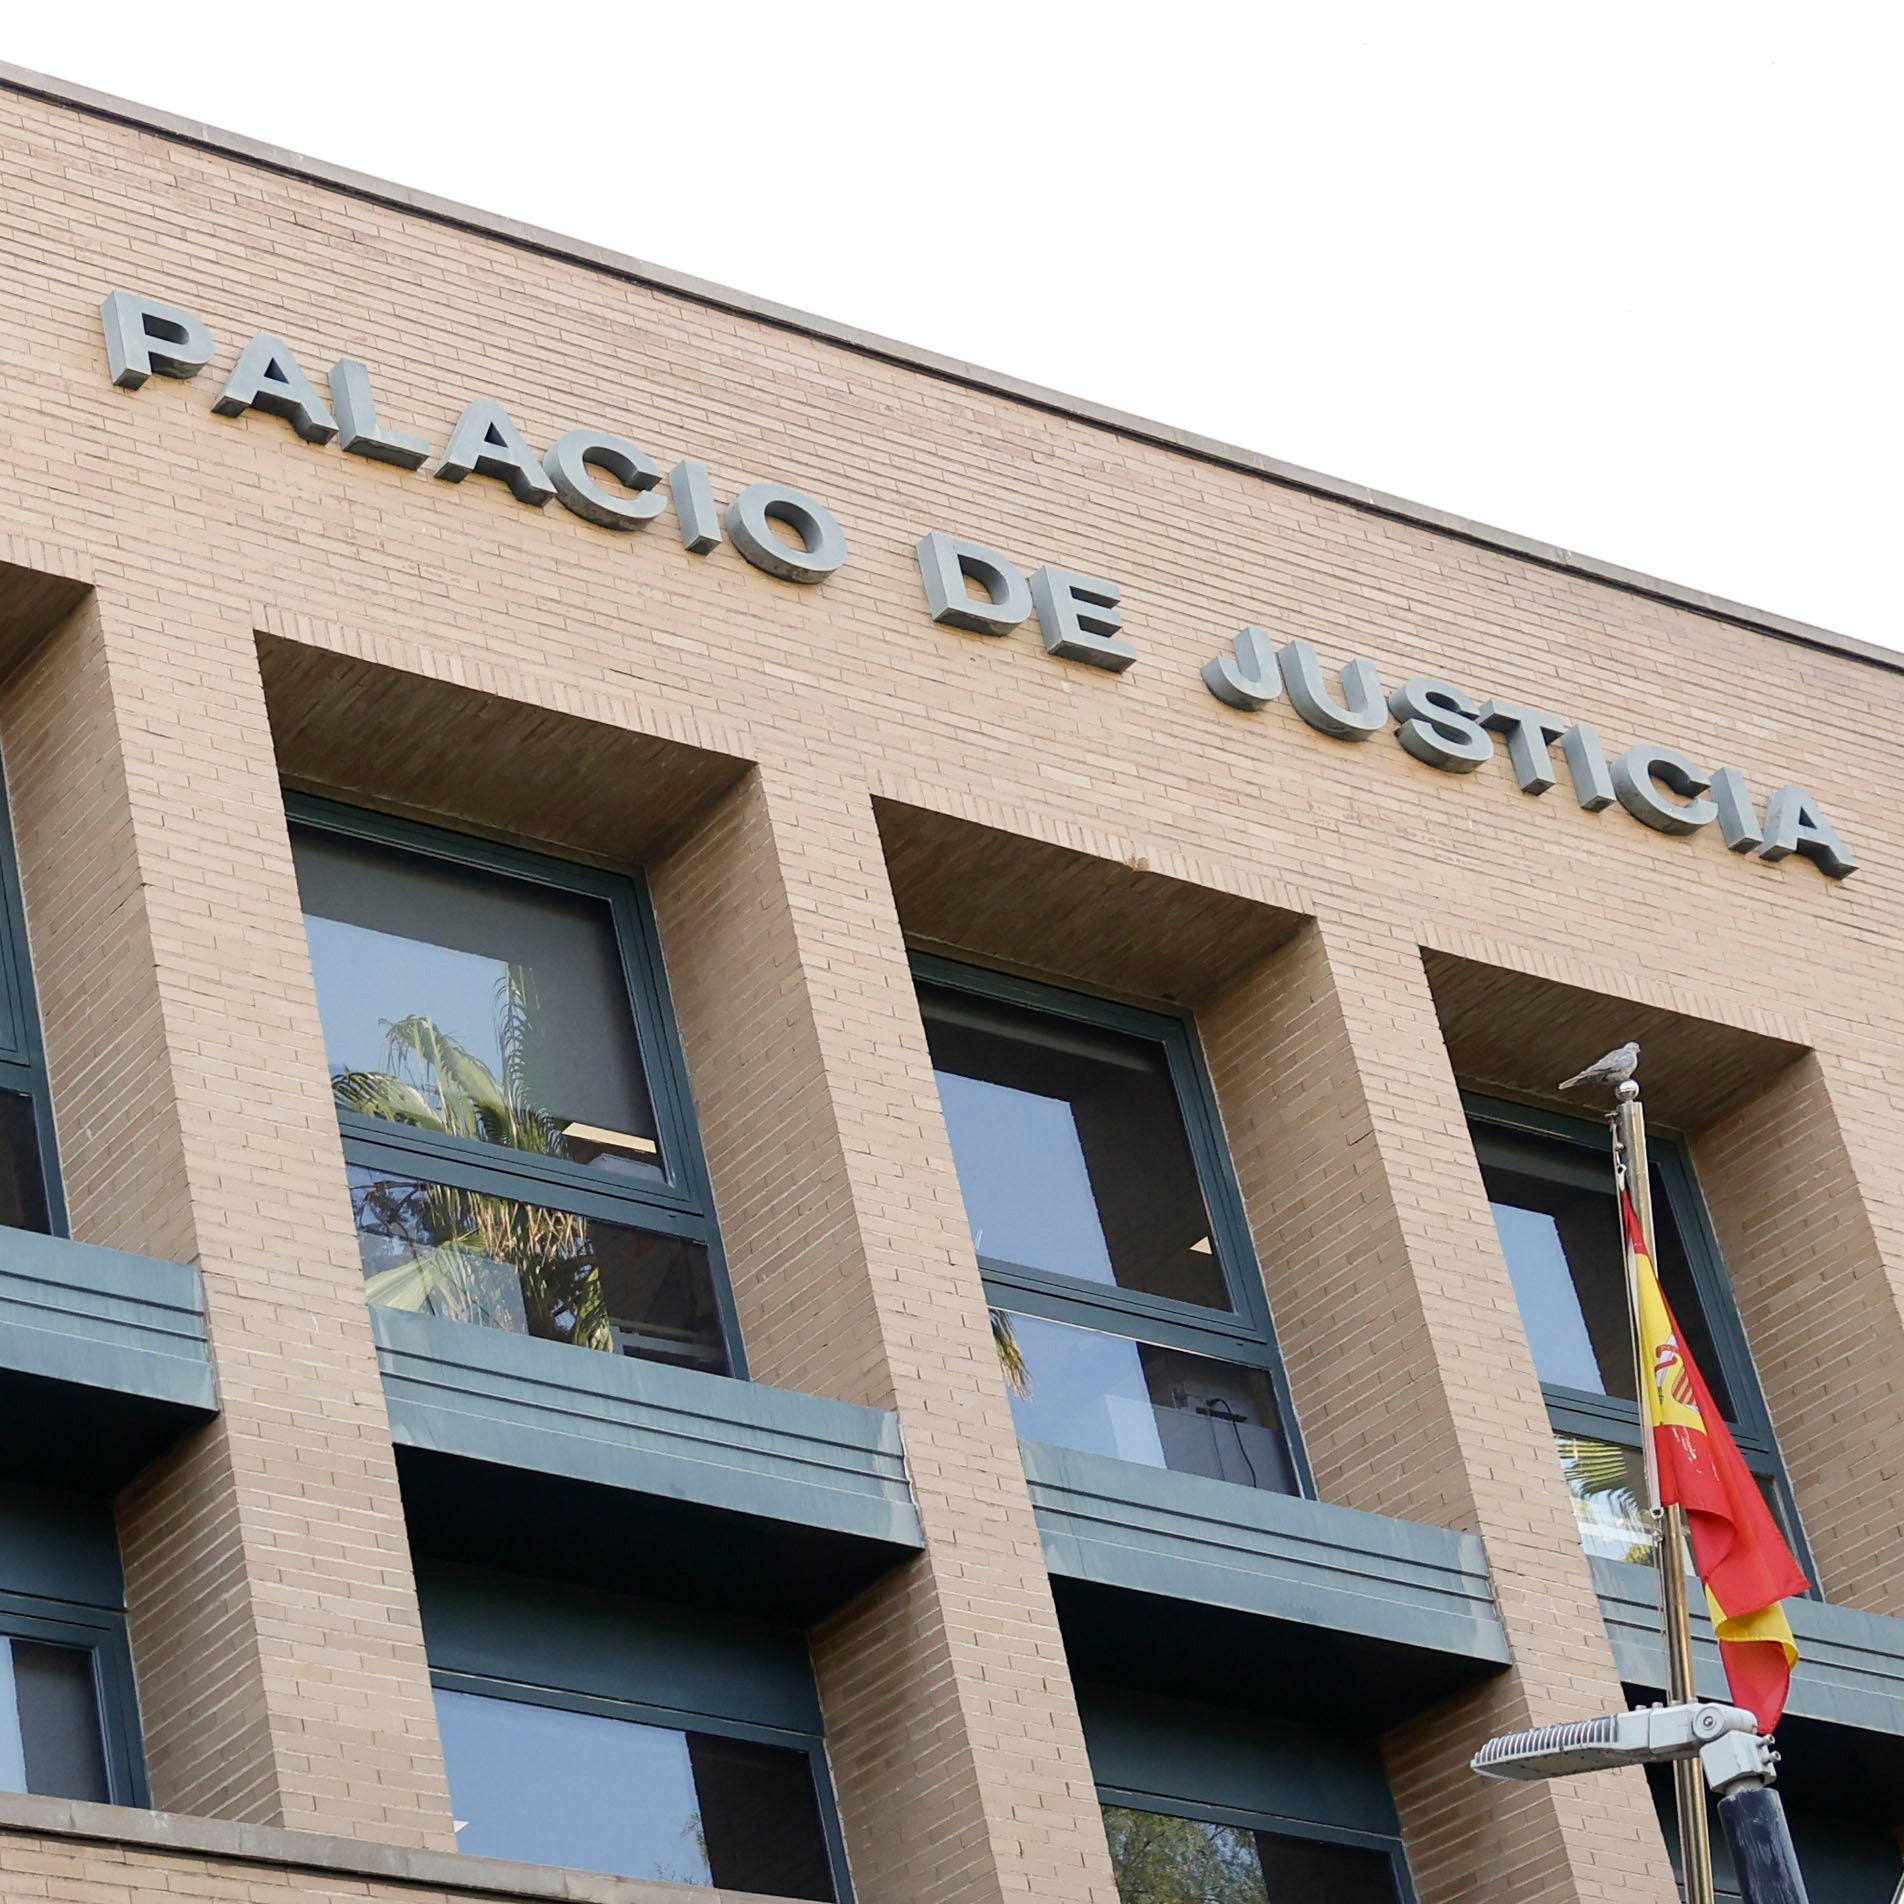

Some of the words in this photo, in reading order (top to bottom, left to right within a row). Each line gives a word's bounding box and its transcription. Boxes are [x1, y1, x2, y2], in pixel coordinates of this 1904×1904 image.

[100, 289, 848, 585] PALACIO
[916, 532, 1138, 674] DE
[1201, 626, 1860, 881] JUSTICIA
